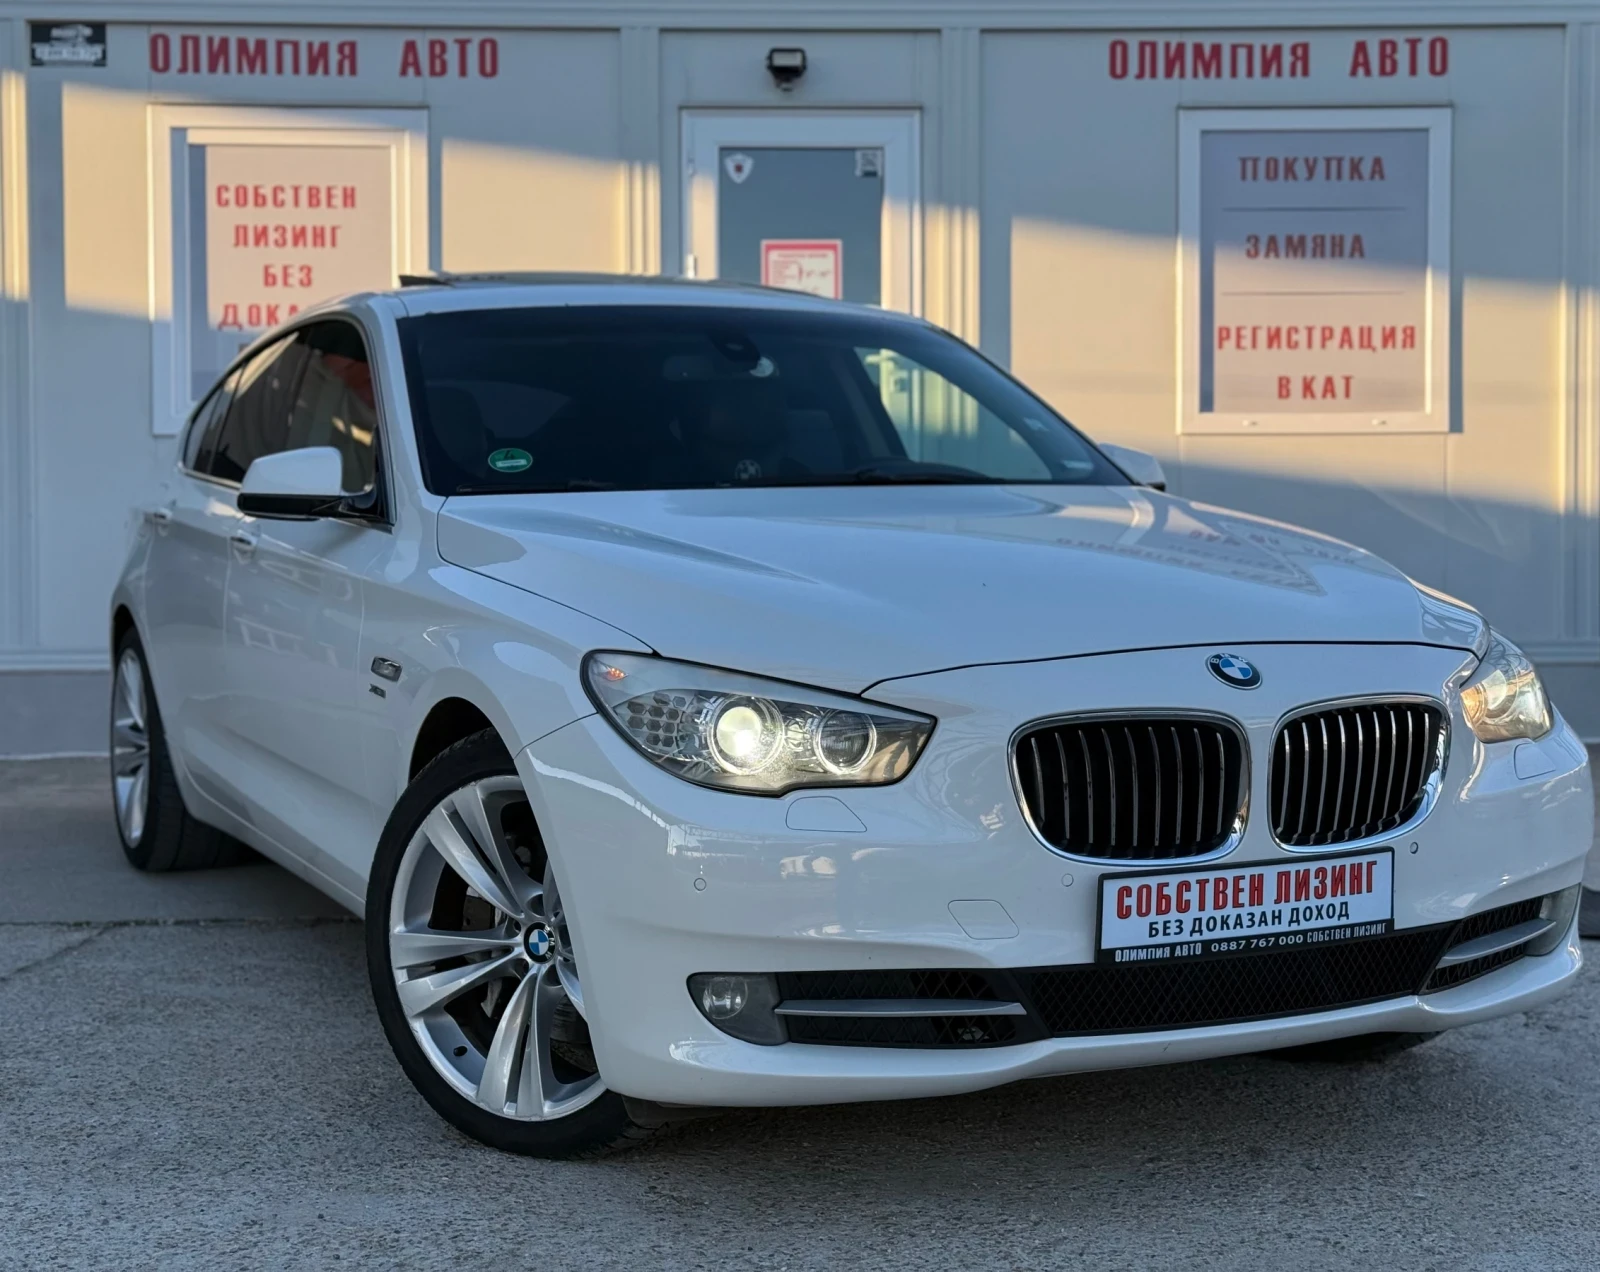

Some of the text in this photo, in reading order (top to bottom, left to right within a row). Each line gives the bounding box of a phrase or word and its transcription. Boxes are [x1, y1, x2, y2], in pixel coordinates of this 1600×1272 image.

[149, 33, 358, 76] ОЛИМПИЯ
[399, 38, 499, 78] АВТО
[1108, 36, 1449, 80] ОЛИМПИЯ АВТО
[1239, 156, 1385, 182] ПОКУПКА
[216, 184, 357, 209] СОБСТВЕН
[233, 224, 341, 249] ЛИЗИНГ
[1245, 234, 1365, 259] ЗАМЯНА
[263, 264, 313, 288] БЕЗ
[1216, 325, 1417, 352] РЕГИСТРАЦИЯ
[1277, 375, 1355, 399] В КАТ
[1116, 861, 1378, 919] СОБСТВЕН ЛИЗИНГ
[1149, 901, 1350, 938] БЕЗ ДОКАЗАН ДОХОД
[1115, 922, 1387, 963] ОЛИМПИЯ АВТО 0887 767 000 СОБСТВЕН ЛИЗИНГ
